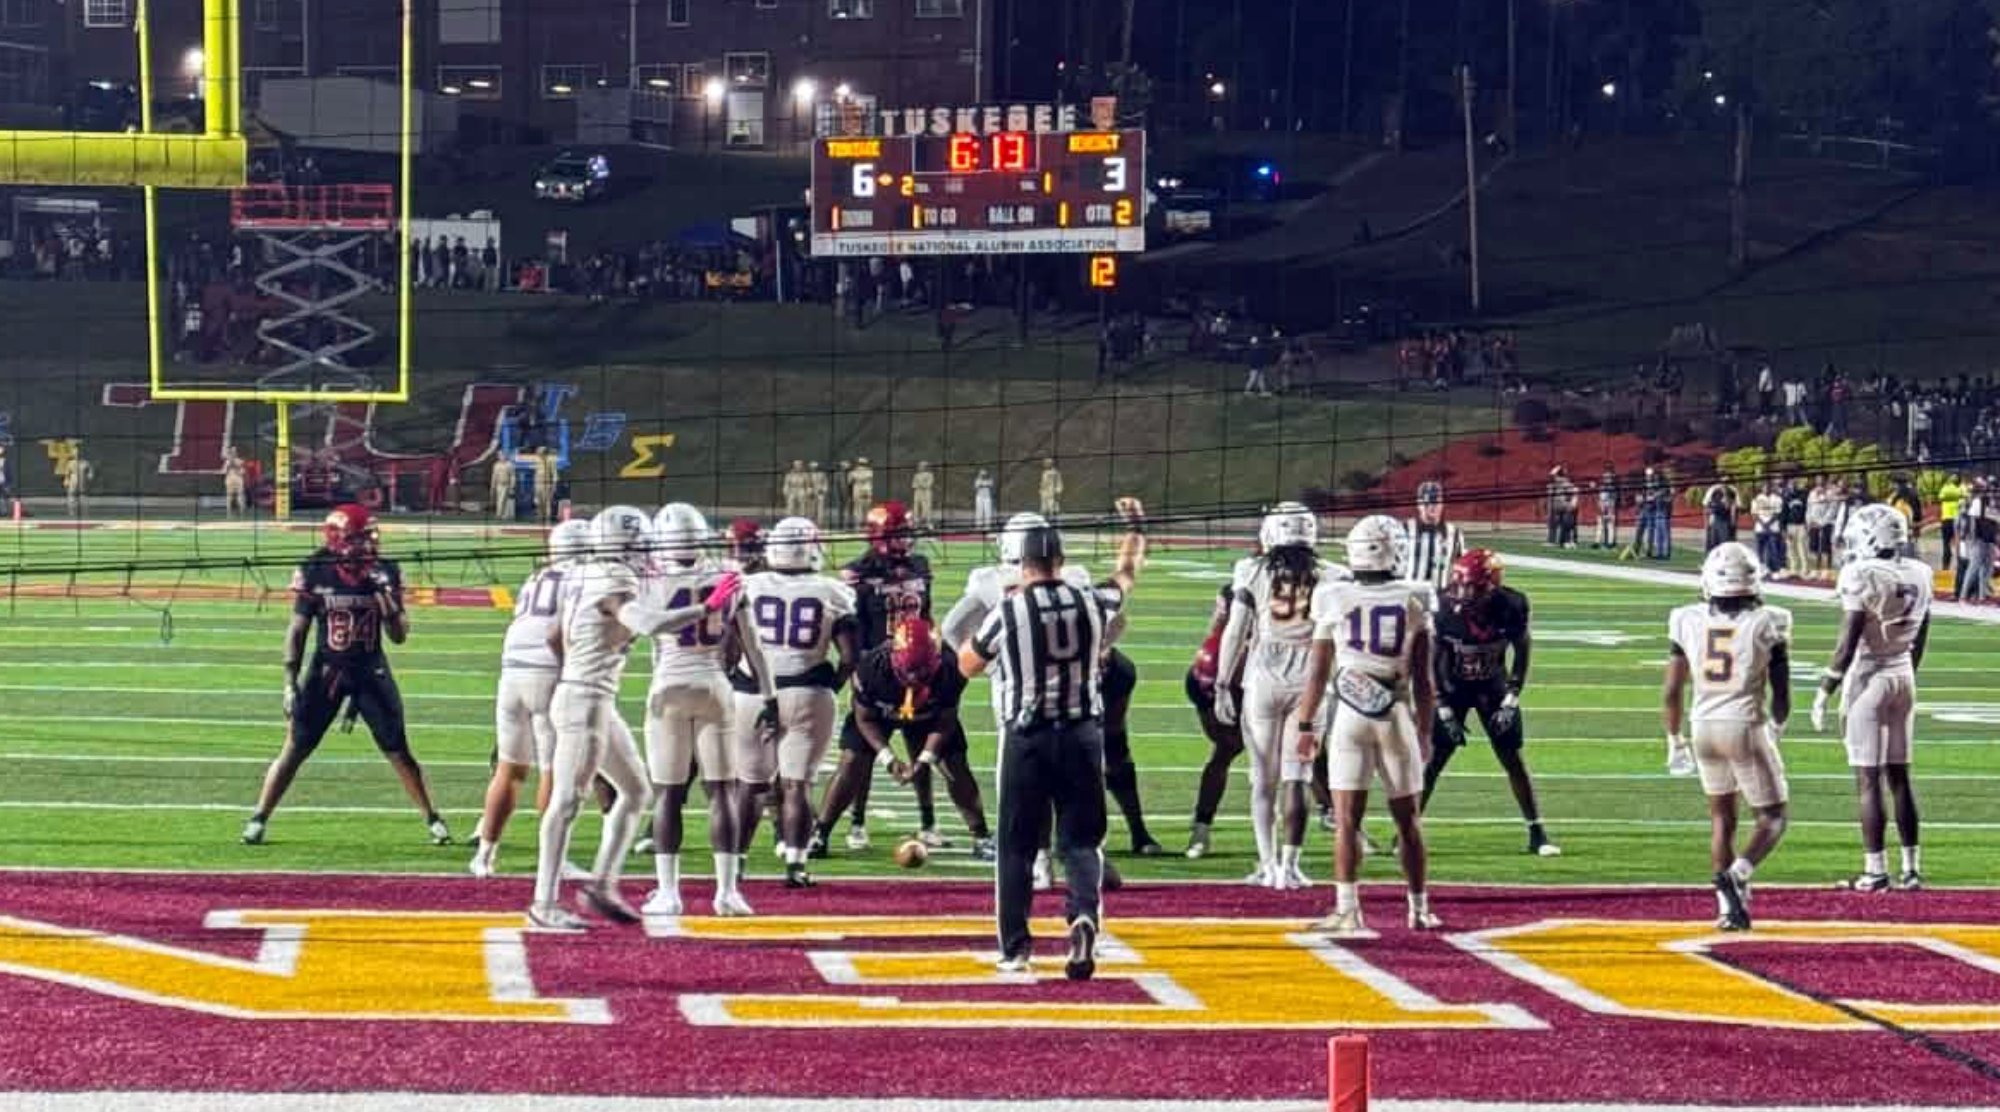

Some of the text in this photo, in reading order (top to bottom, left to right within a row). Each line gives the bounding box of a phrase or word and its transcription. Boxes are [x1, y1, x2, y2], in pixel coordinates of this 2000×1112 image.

[881, 104, 1076, 137] TUSKEGEE
[951, 136, 1025, 170] 6:13
[853, 163, 874, 197] 6
[901, 175, 914, 196] 2
[1103, 157, 1126, 191] 3
[1115, 200, 1132, 225] 2
[839, 239, 1117, 253] TUSKEGE NATIONAL ALUMNI ASSOCIATION
[1091, 257, 1115, 287] 12
[327, 609, 379, 652] 84
[754, 595, 823, 649] 98
[1040, 609, 1080, 660] U
[1346, 605, 1406, 655] 10
[1704, 627, 1737, 682] 5
